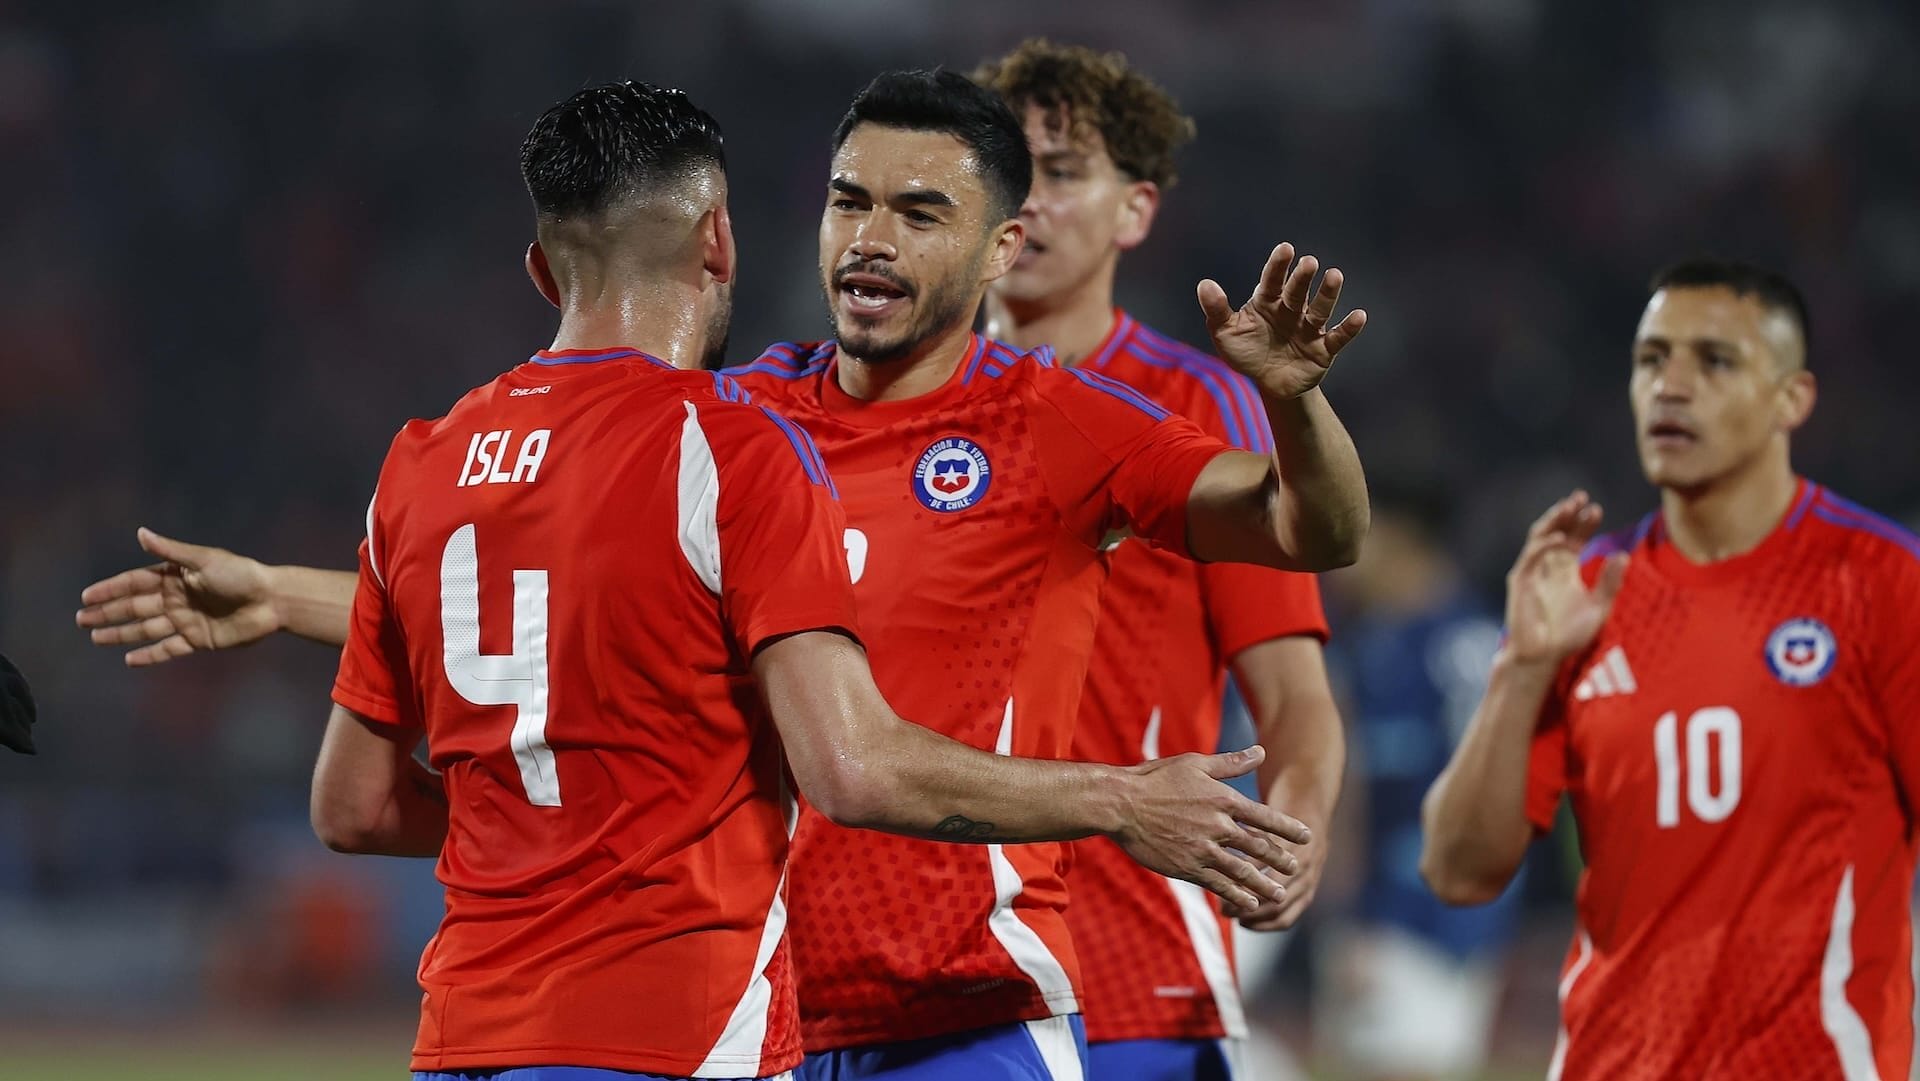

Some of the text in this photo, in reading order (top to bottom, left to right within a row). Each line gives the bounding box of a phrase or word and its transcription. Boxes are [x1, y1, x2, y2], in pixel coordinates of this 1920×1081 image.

[457, 429, 552, 487] ISLA
[915, 439, 990, 478] FEDERACION DE FUTBOL
[930, 497, 969, 510] DE CHILE
[440, 523, 562, 807] 4
[1654, 705, 1742, 829] 10
